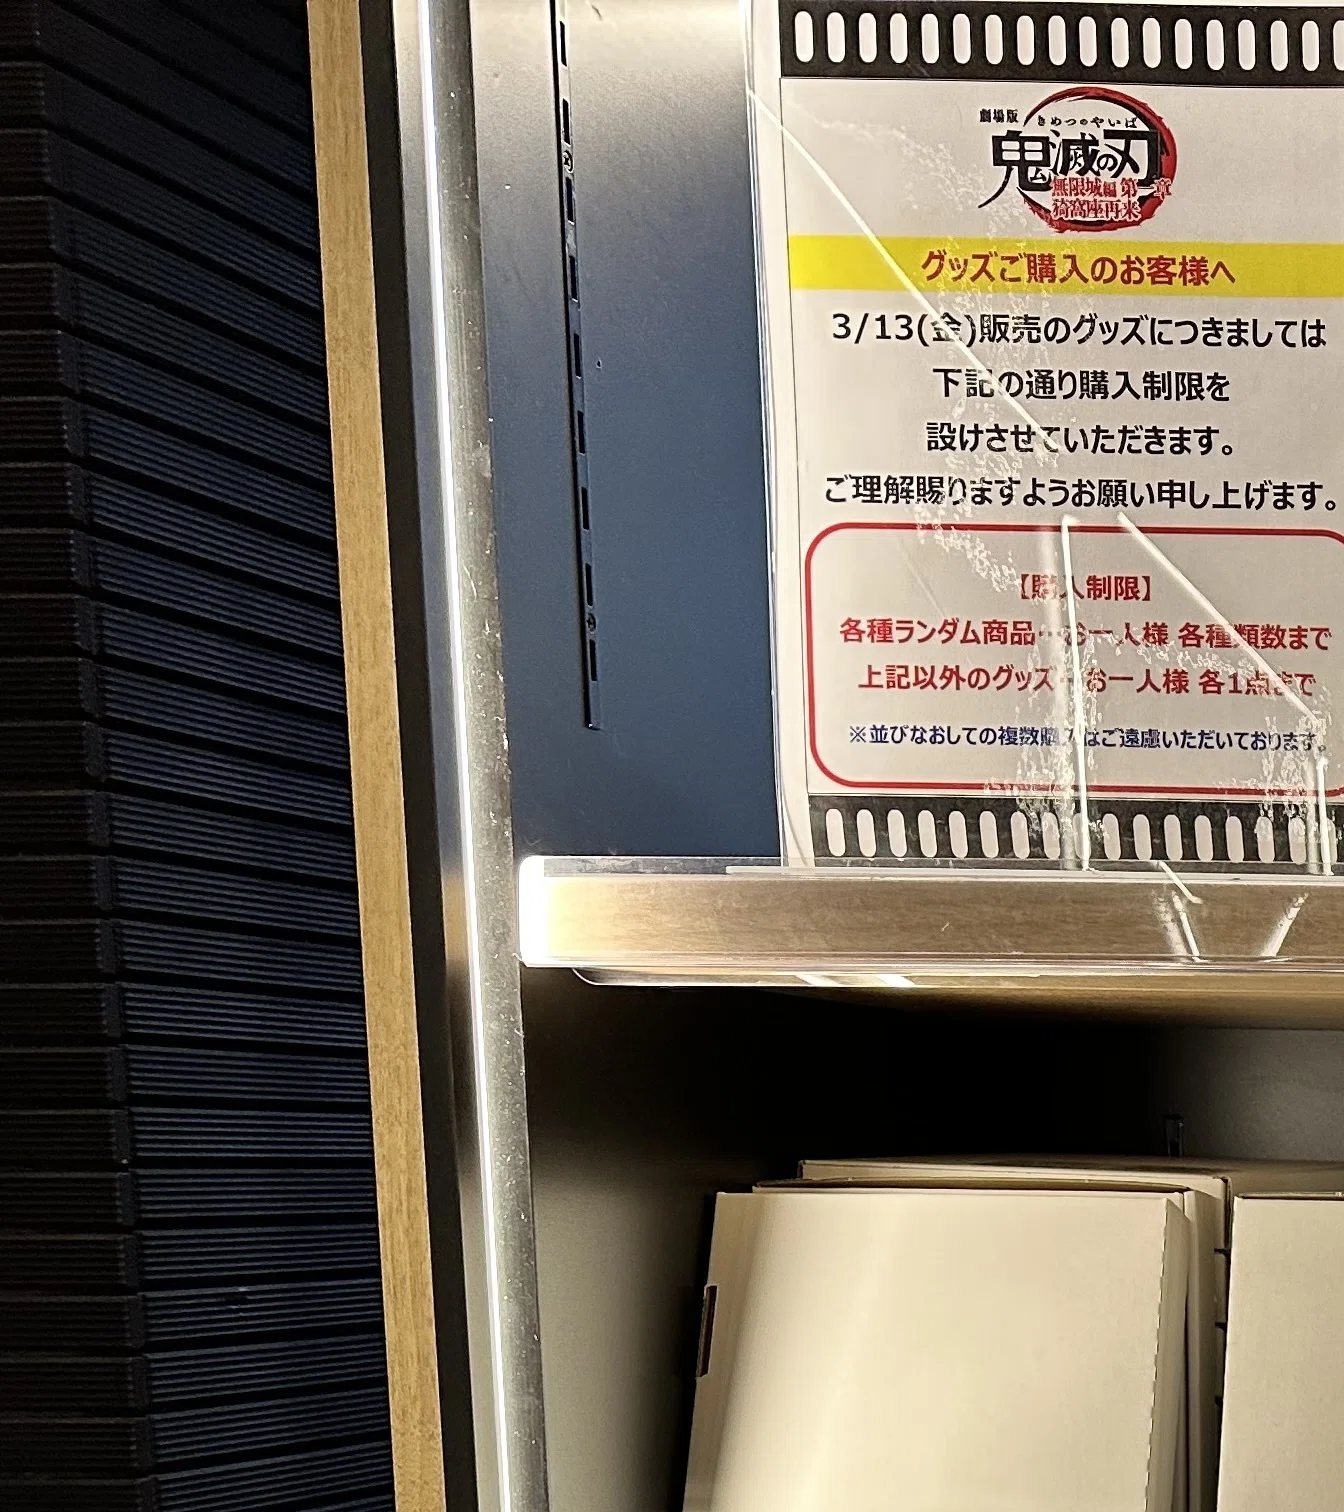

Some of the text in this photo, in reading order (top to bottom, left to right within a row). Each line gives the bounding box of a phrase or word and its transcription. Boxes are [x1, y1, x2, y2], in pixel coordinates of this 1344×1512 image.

[980, 109, 1019, 124] 劇場版
[978, 129, 1163, 208] 鬼滅の刃
[921, 250, 1236, 287] グッズご購入のお客様へ
[831, 312, 1328, 350] 3/13(金)販売のグッズにつきましては
[932, 367, 1231, 402] 下記の通り購入制限を
[925, 422, 1235, 458] 設けさせていただきます。
[825, 474, 1338, 512] ご理解賜りますようお願い申し上げます。
[1177, 621, 1333, 651] 各種類数まで
